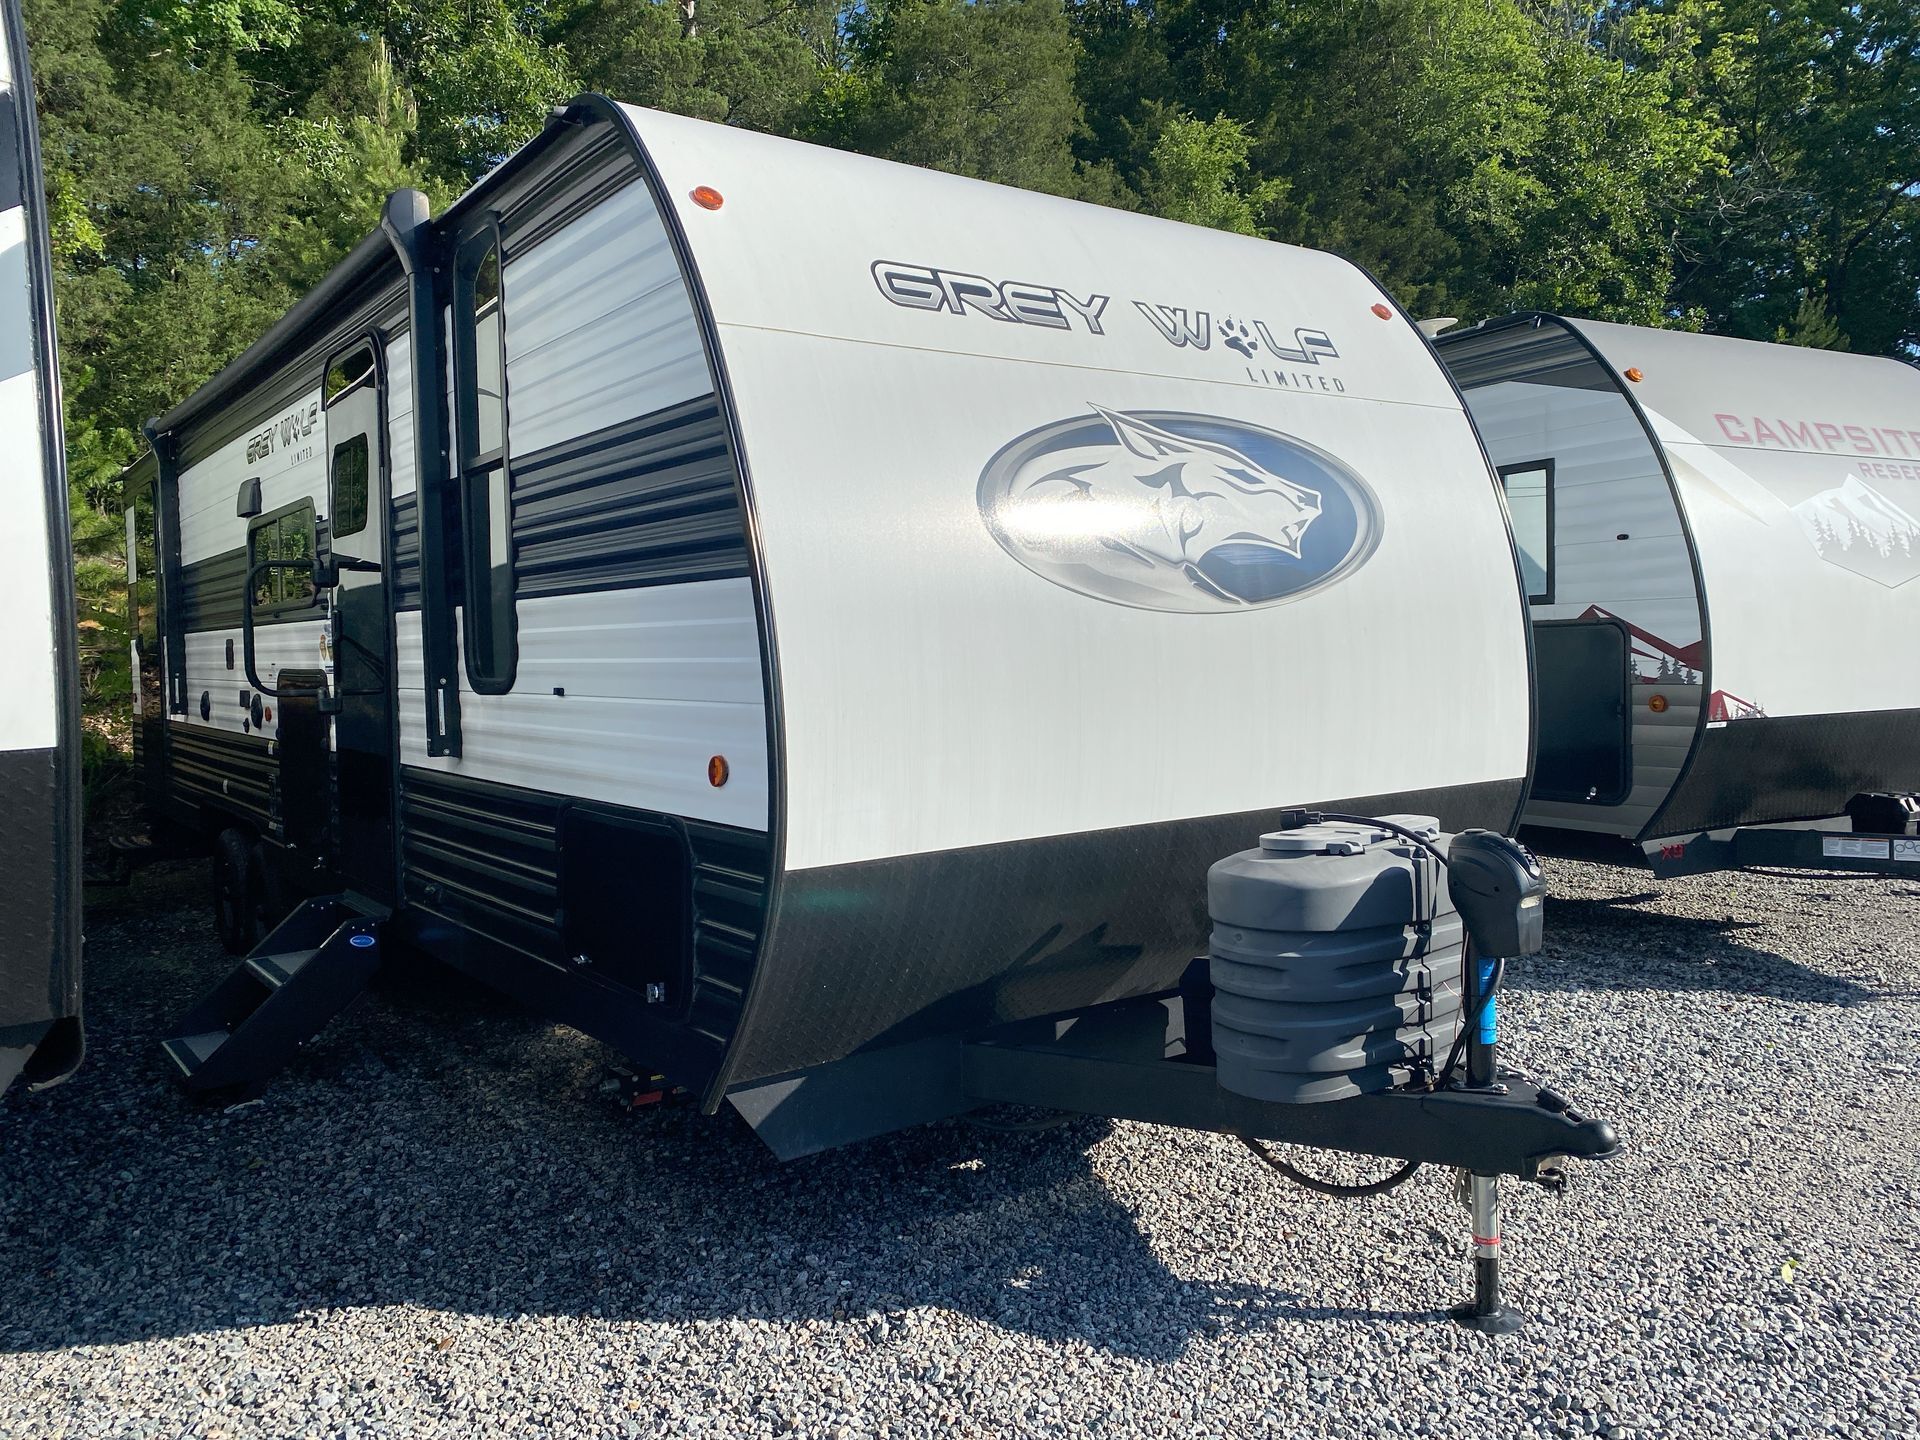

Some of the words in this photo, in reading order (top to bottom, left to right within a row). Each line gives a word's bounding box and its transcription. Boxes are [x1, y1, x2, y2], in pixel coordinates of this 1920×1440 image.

[870, 259, 1110, 335] GREY
[1245, 366, 1346, 393] LIMITED
[246, 424, 278, 465] GREY
[291, 446, 312, 465] LIMITED
